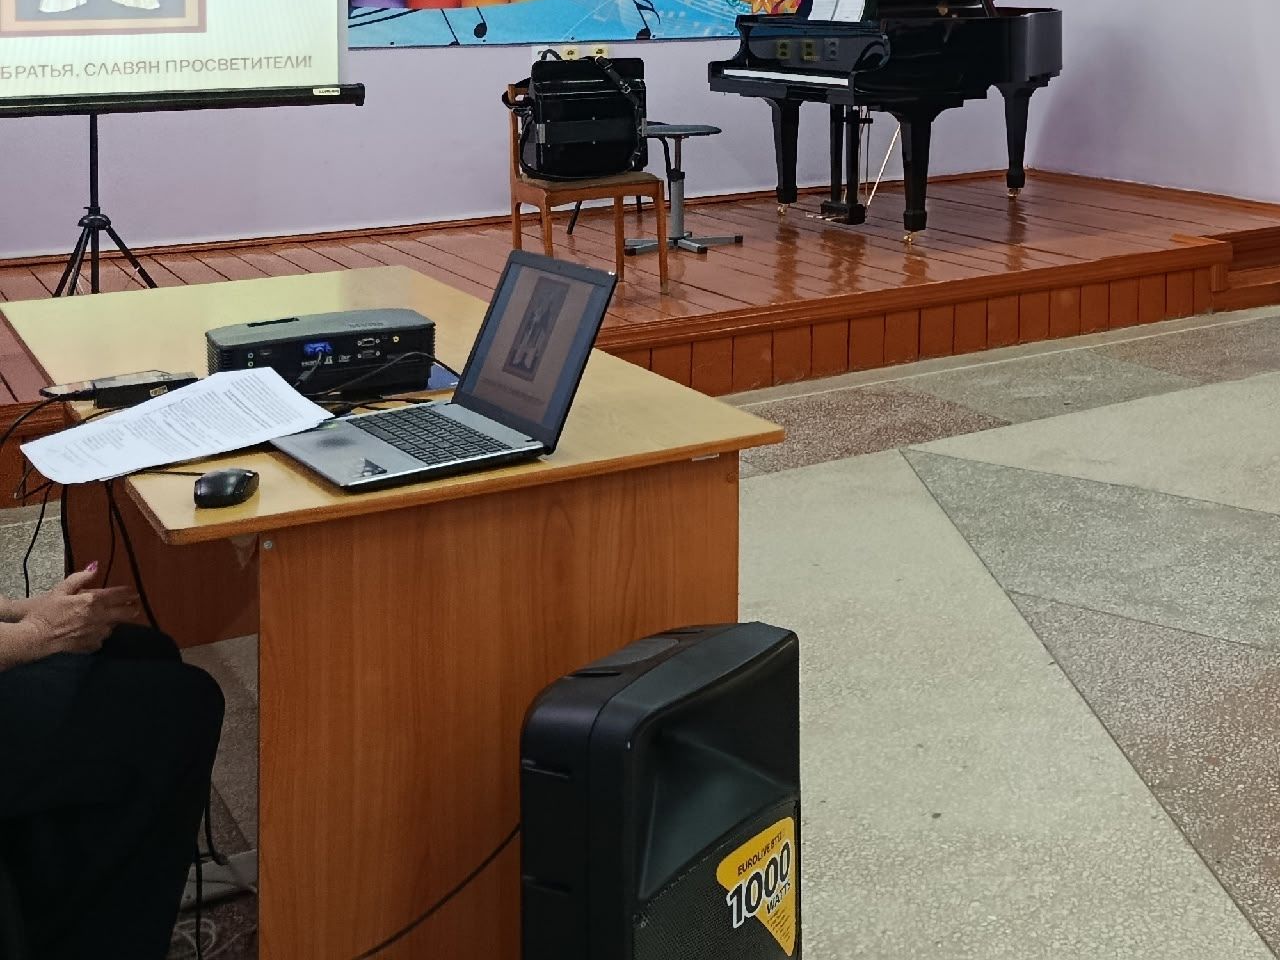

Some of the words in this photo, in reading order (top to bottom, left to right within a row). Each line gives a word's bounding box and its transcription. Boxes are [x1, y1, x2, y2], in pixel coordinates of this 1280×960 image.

[84, 60, 160, 77] СЛАВЯН
[165, 55, 312, 73] ПРОСВЕТИТЕЛИ!
[727, 840, 791, 928] 1000
